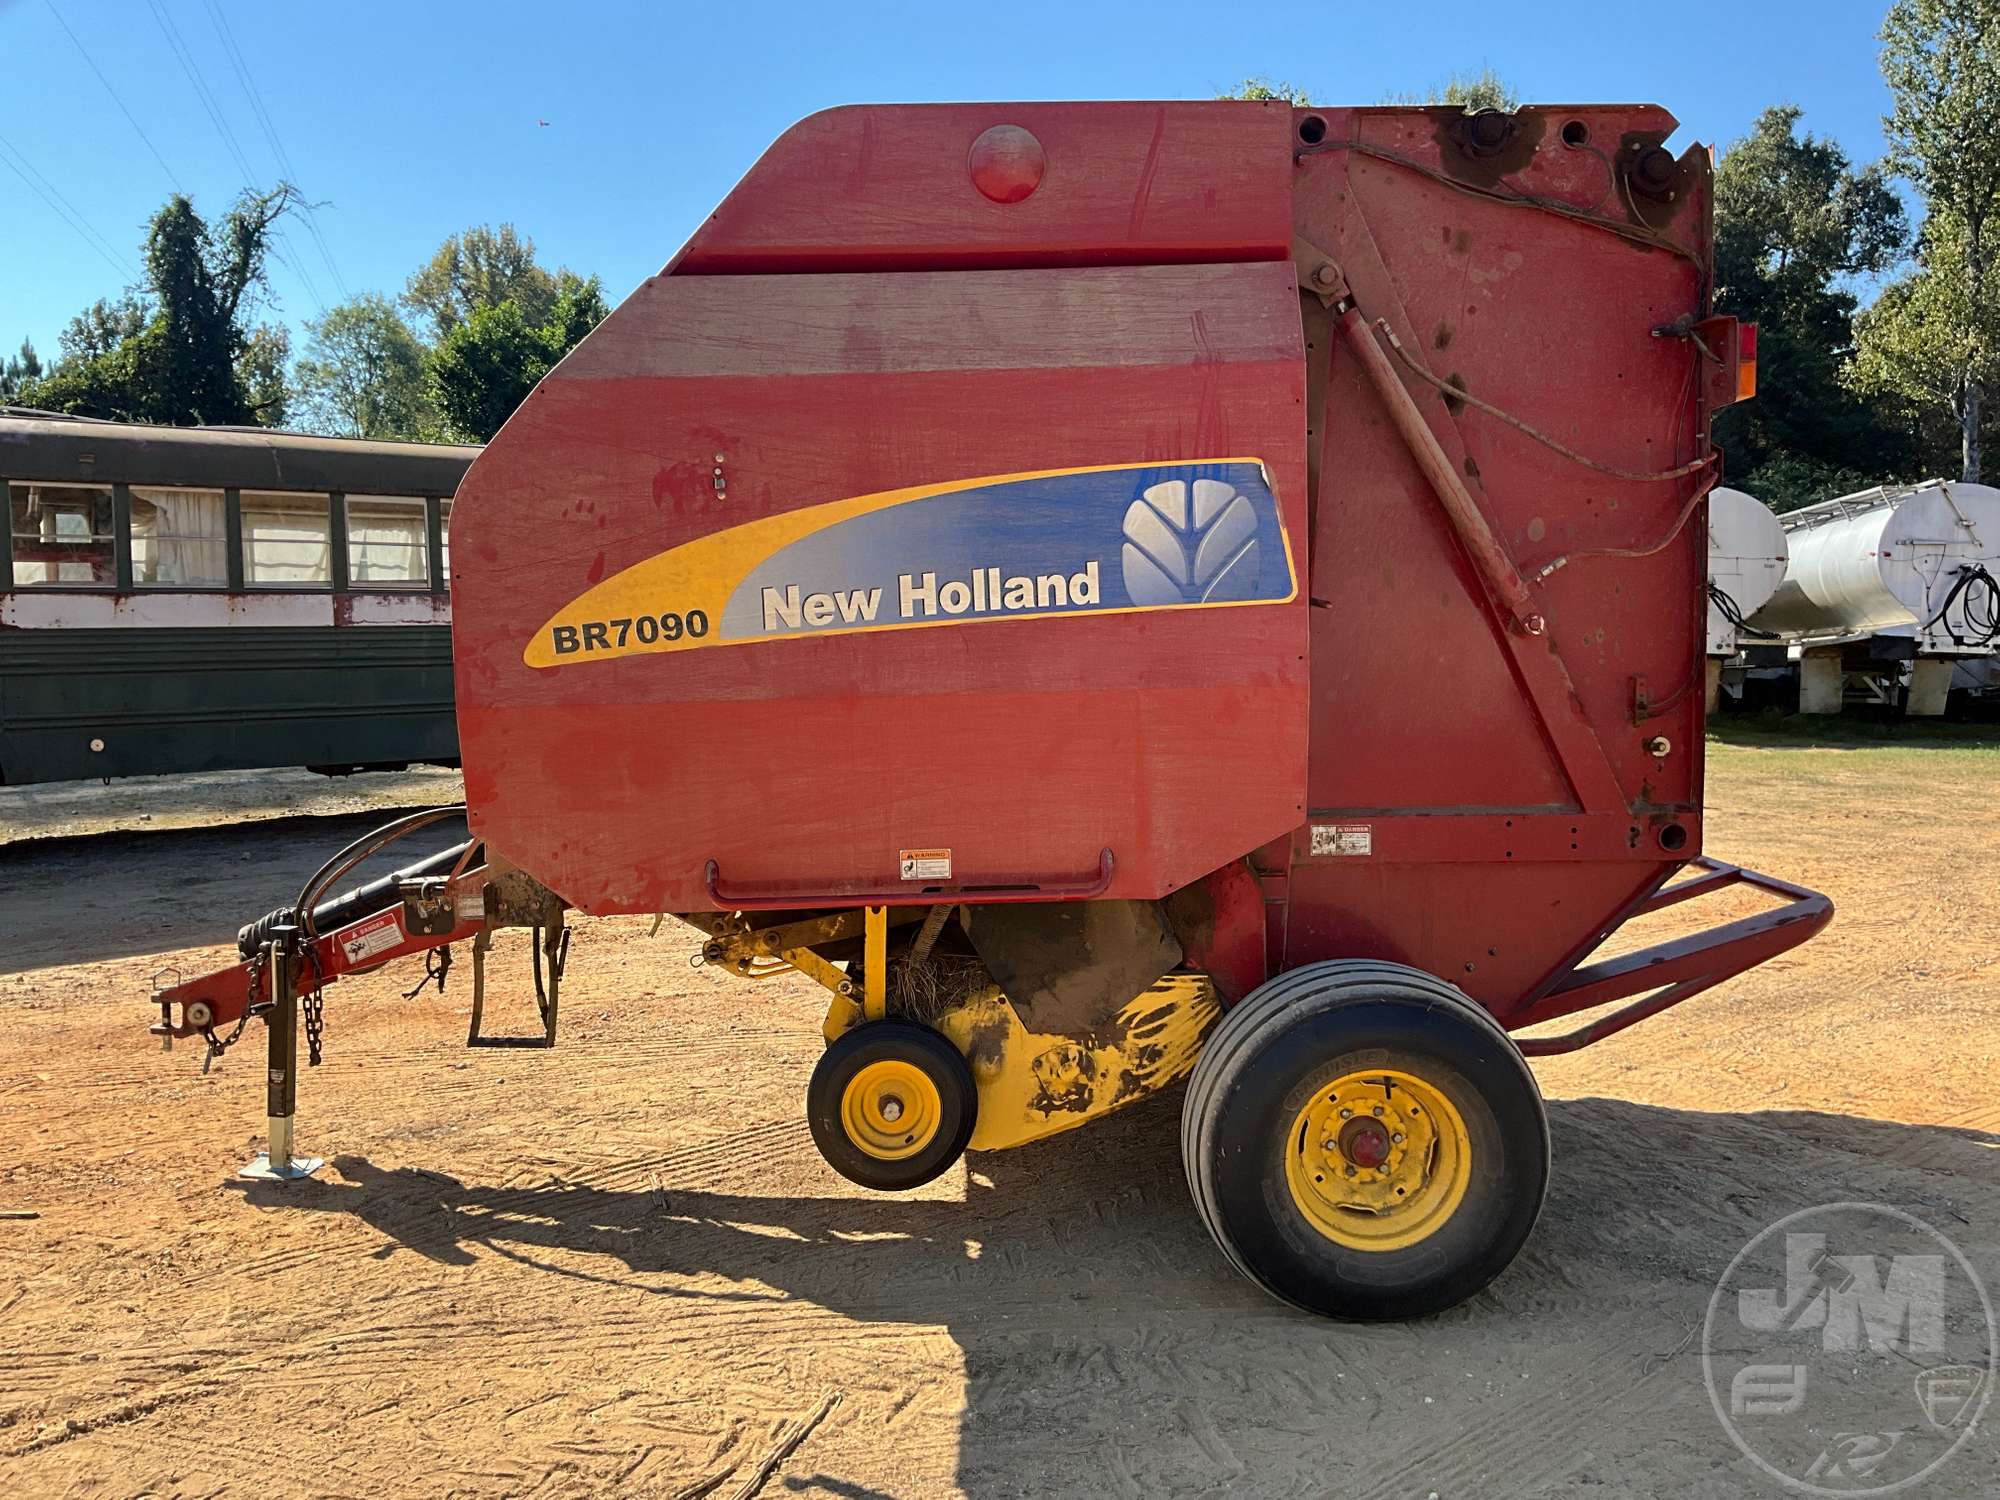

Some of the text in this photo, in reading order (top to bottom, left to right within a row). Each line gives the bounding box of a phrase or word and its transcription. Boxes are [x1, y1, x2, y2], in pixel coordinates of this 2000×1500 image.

[761, 561, 1100, 633] New Holland
[552, 609, 710, 657] BR7090
[360, 920, 385, 935] DANGER
